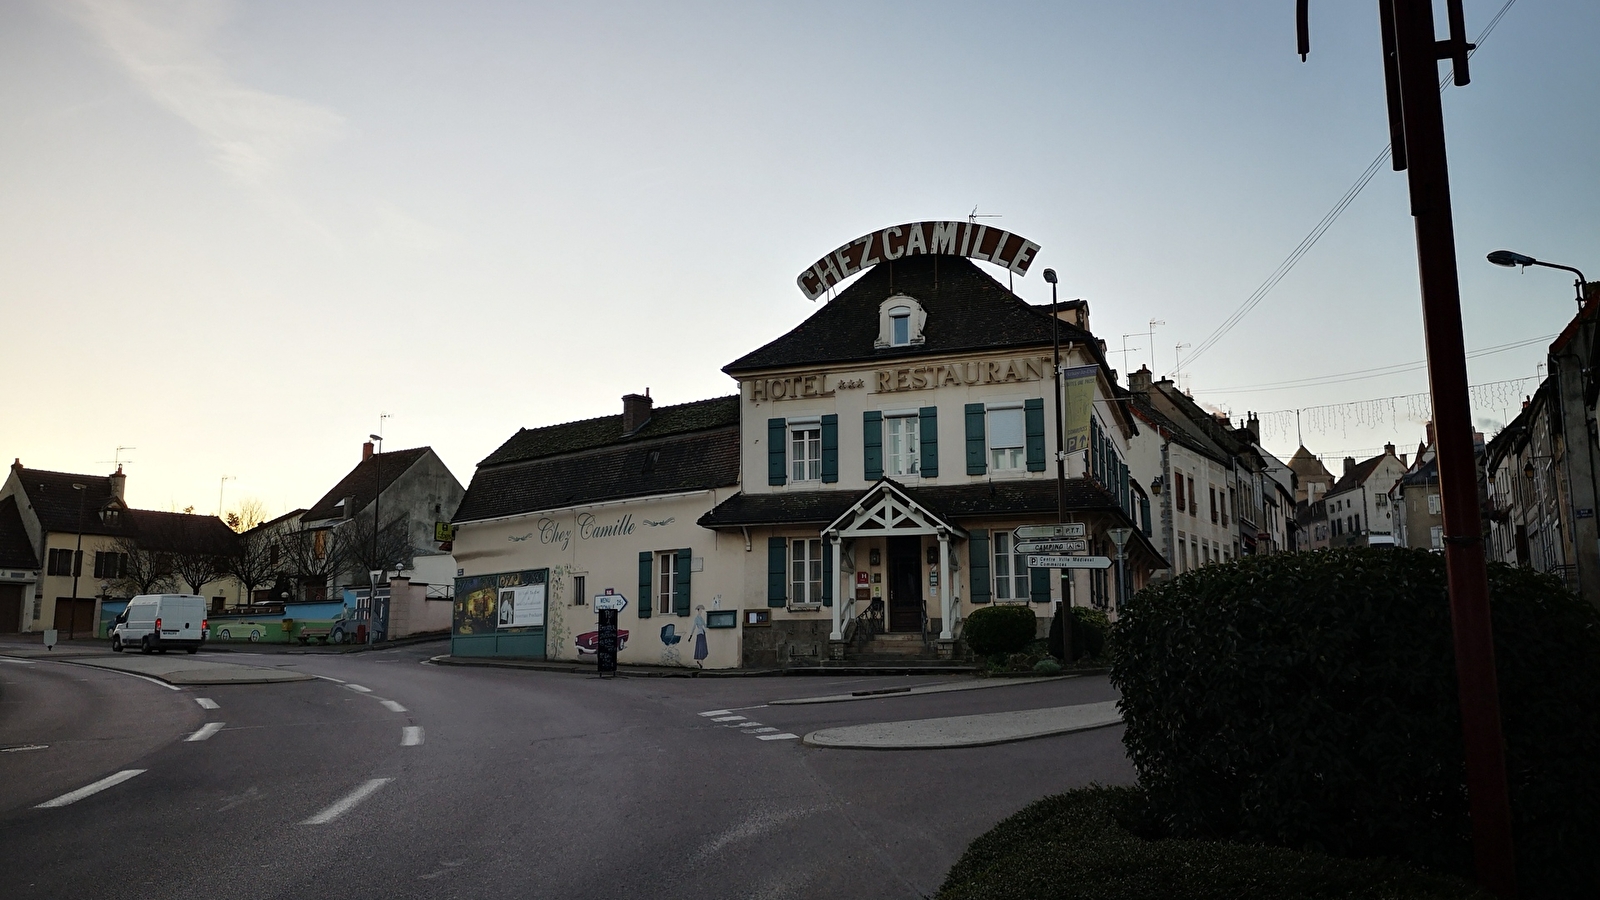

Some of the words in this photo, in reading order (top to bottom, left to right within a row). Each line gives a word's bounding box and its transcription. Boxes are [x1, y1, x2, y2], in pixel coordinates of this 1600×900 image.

[797, 233, 880, 301] CHEZ
[882, 221, 1041, 277] CAMILLE
[750, 374, 836, 401] HOTEL
[1069, 439, 1076, 451] P
[538, 517, 571, 551] Chez
[577, 512, 637, 540] Camille
